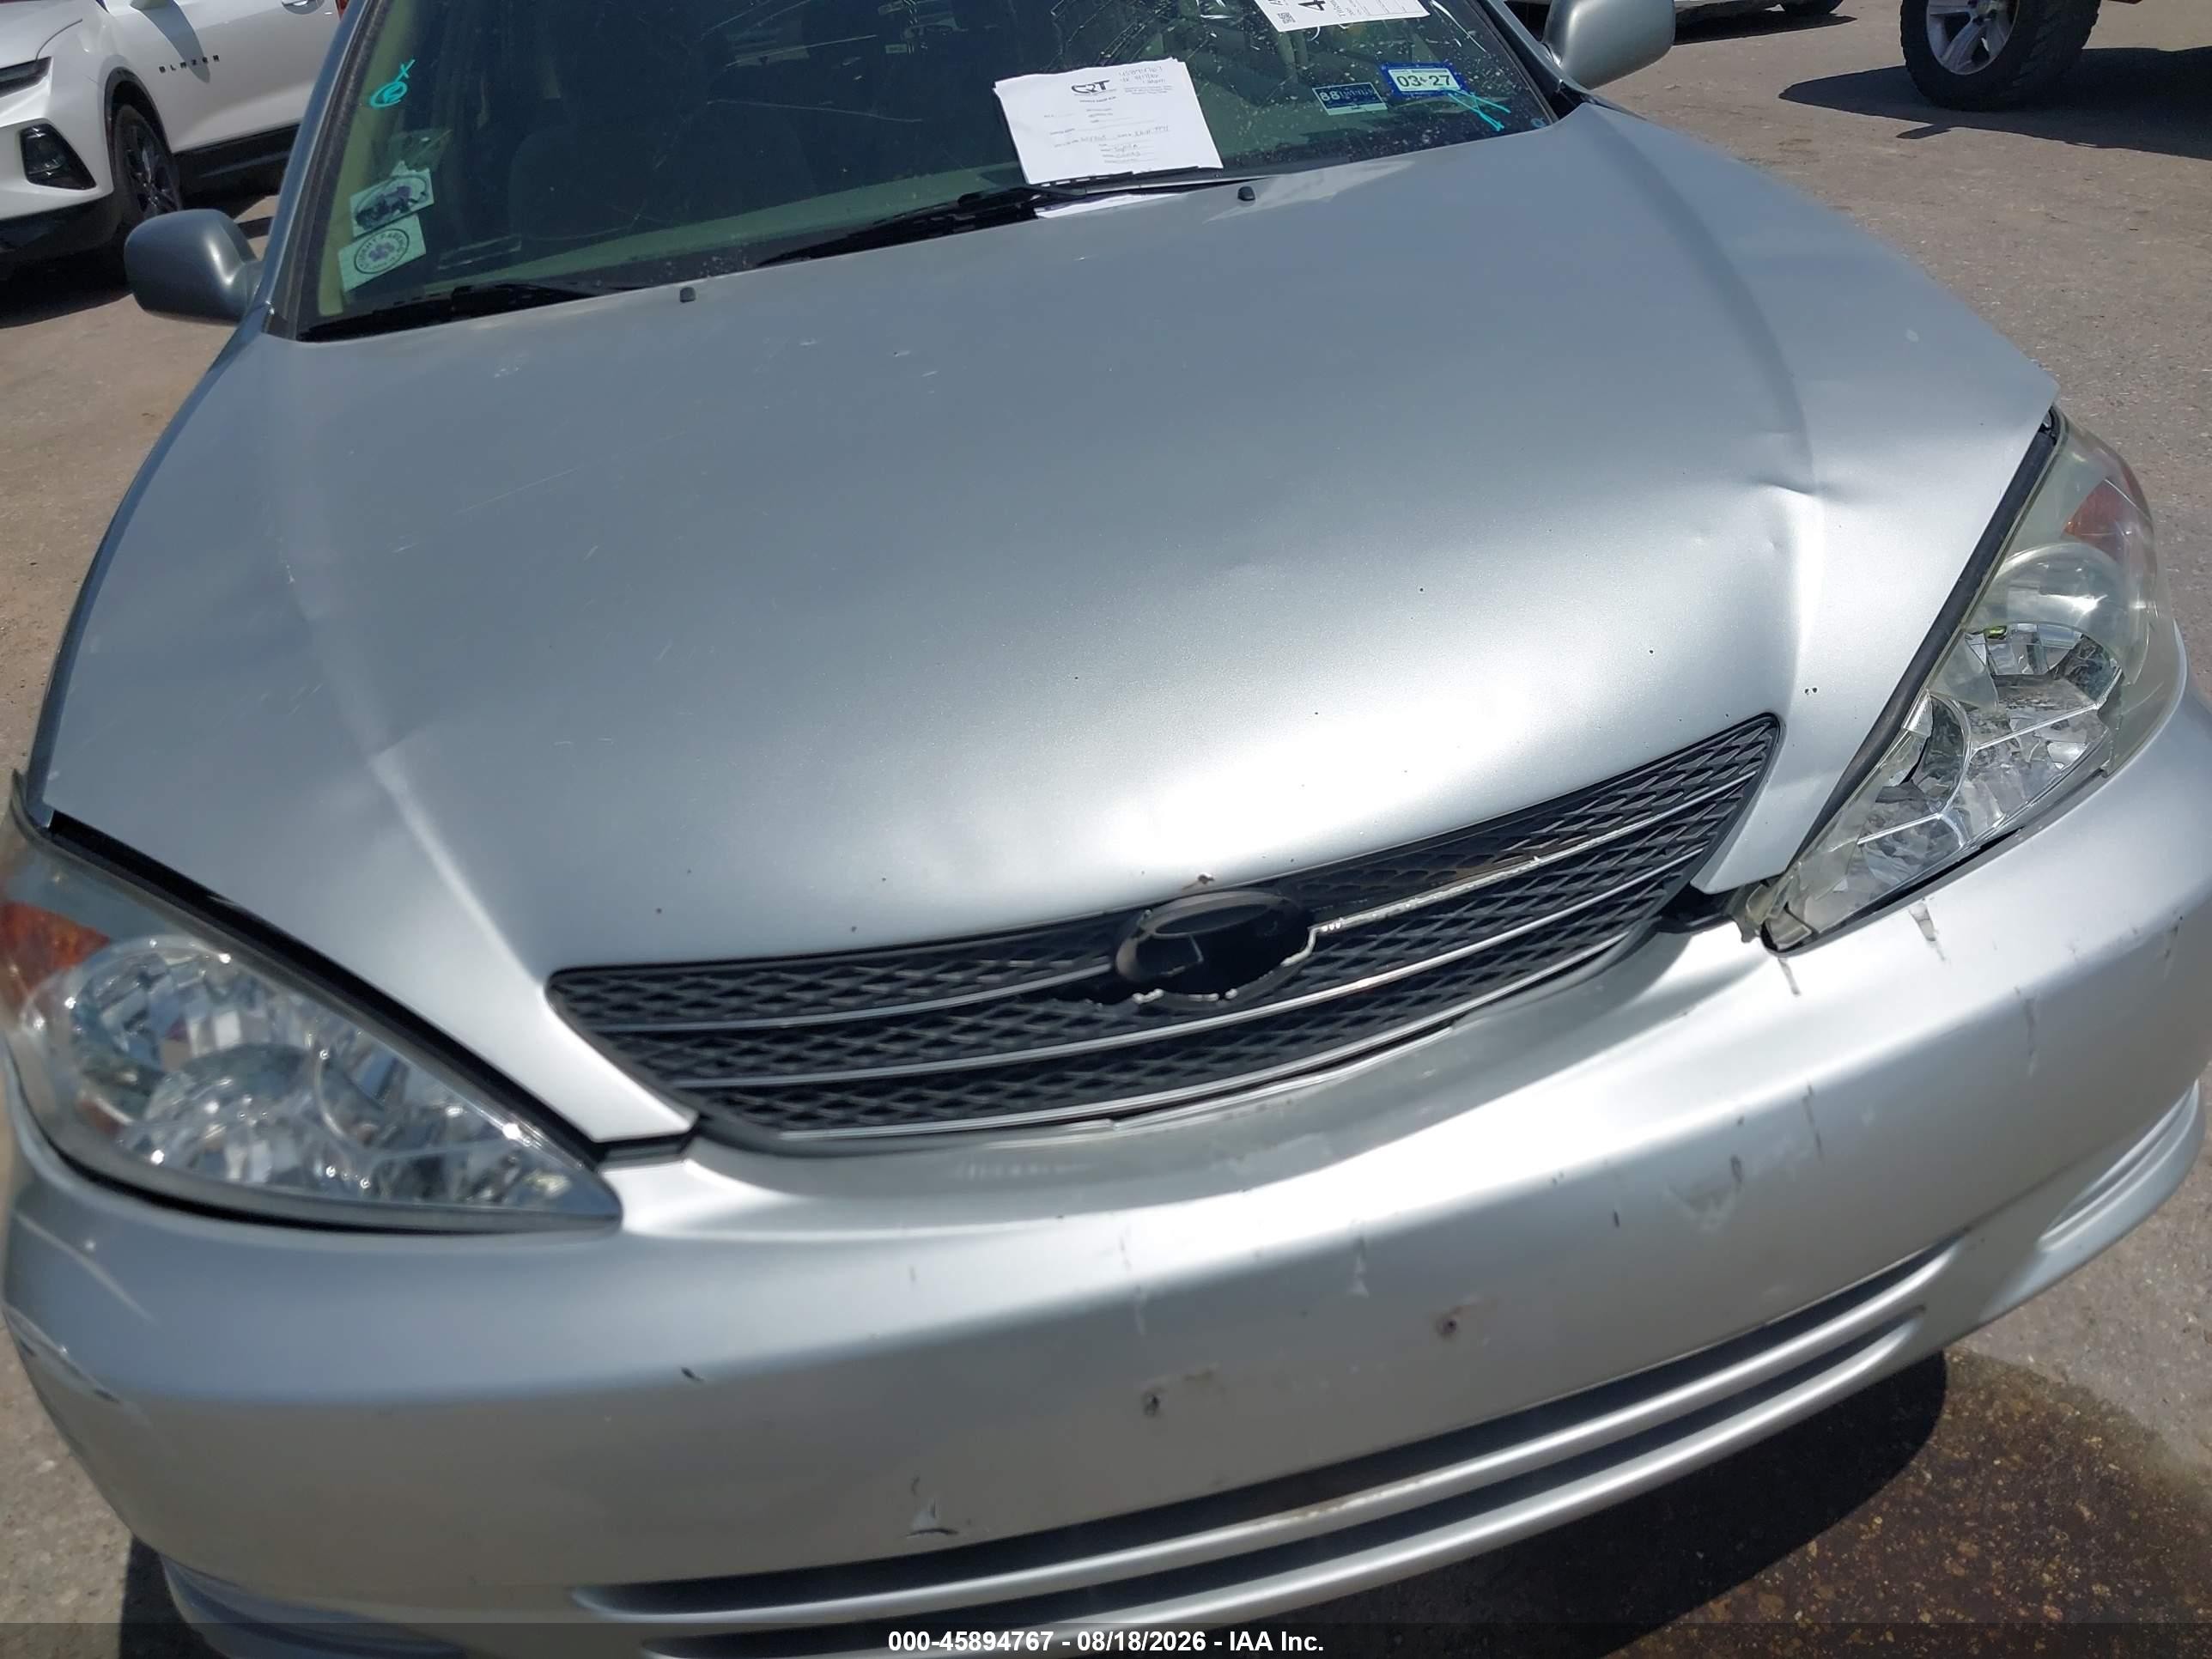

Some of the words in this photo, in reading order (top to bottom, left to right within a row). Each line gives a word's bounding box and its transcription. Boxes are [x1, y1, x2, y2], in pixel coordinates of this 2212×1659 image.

[158, 54, 220, 74] BLAZER
[1396, 75, 1422, 87] 03
[1429, 75, 1450, 86] 27
